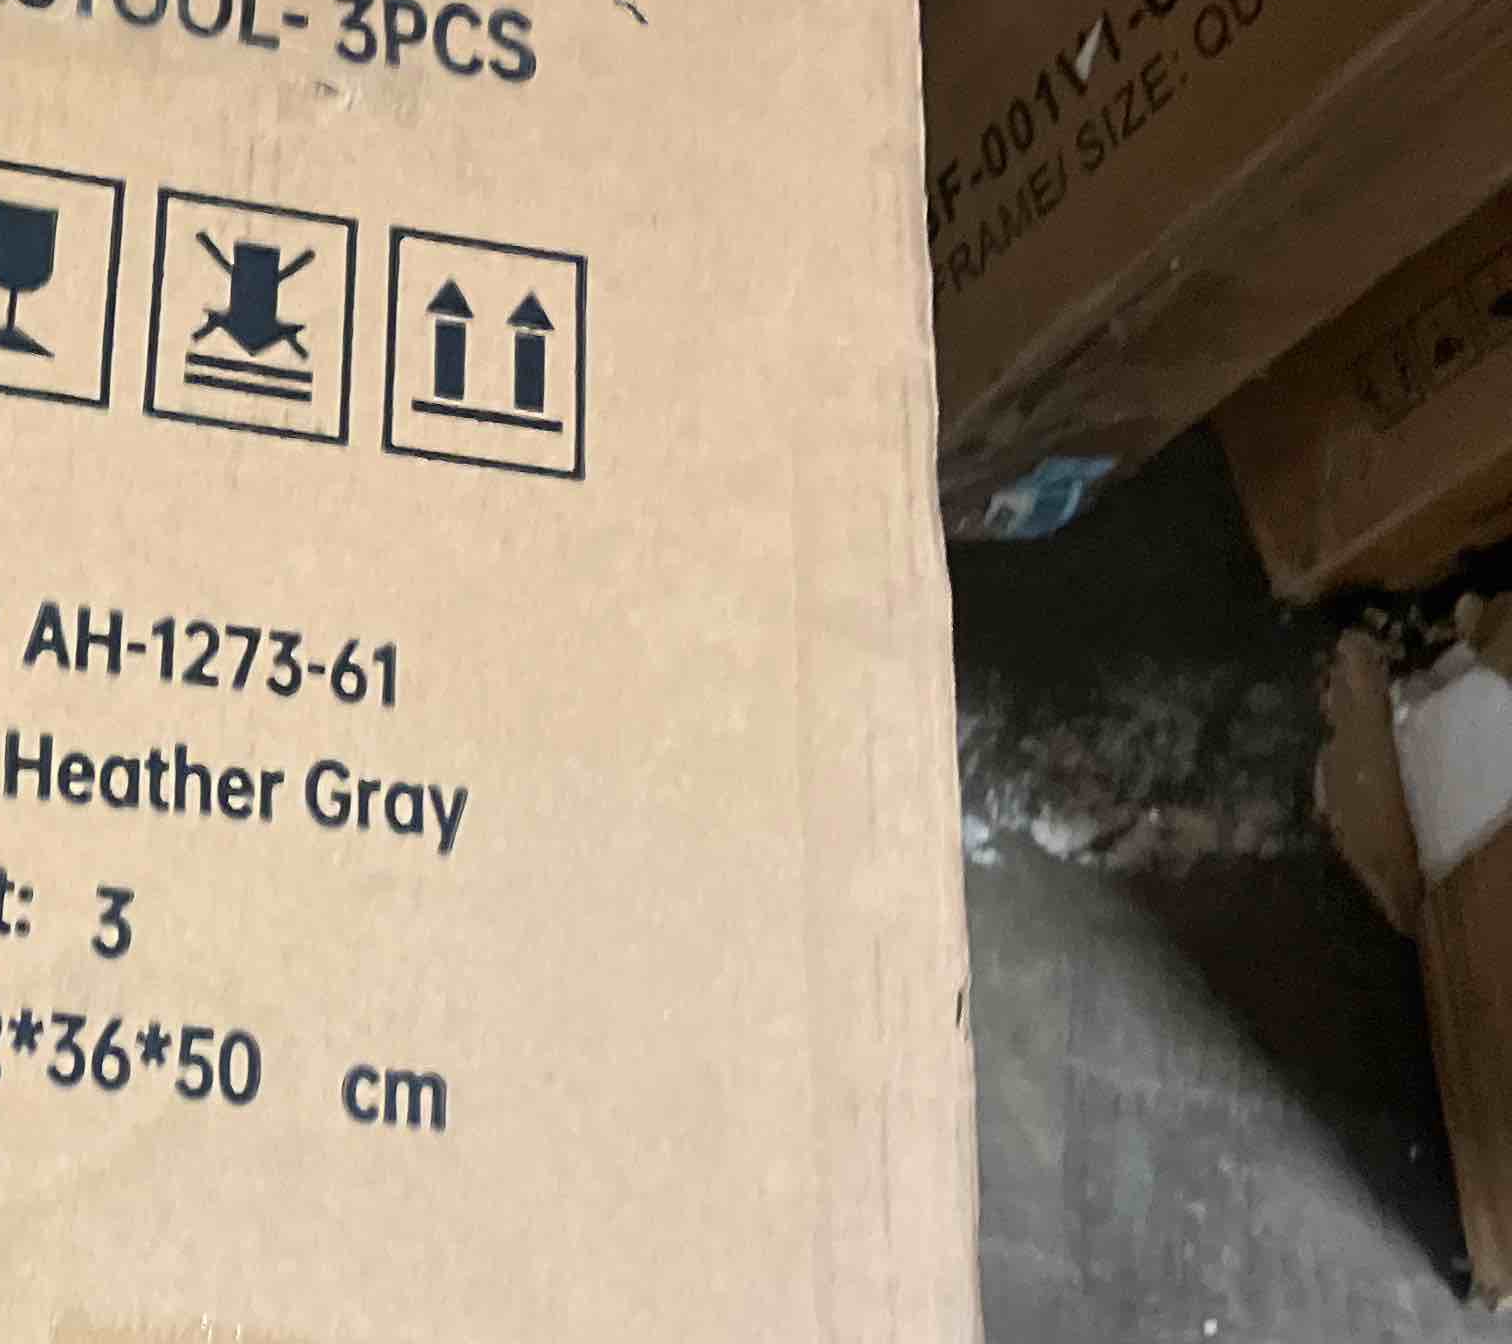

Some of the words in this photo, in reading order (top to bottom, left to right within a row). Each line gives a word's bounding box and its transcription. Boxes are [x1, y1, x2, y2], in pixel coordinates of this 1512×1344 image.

[1076, 46, 1190, 175] SIZE:
[22, 600, 399, 708] AH-1273-61
[3, 728, 285, 822] Heather
[303, 758, 470, 856] Gray
[90, 882, 136, 960] 3
[341, 1061, 449, 1132] cm
